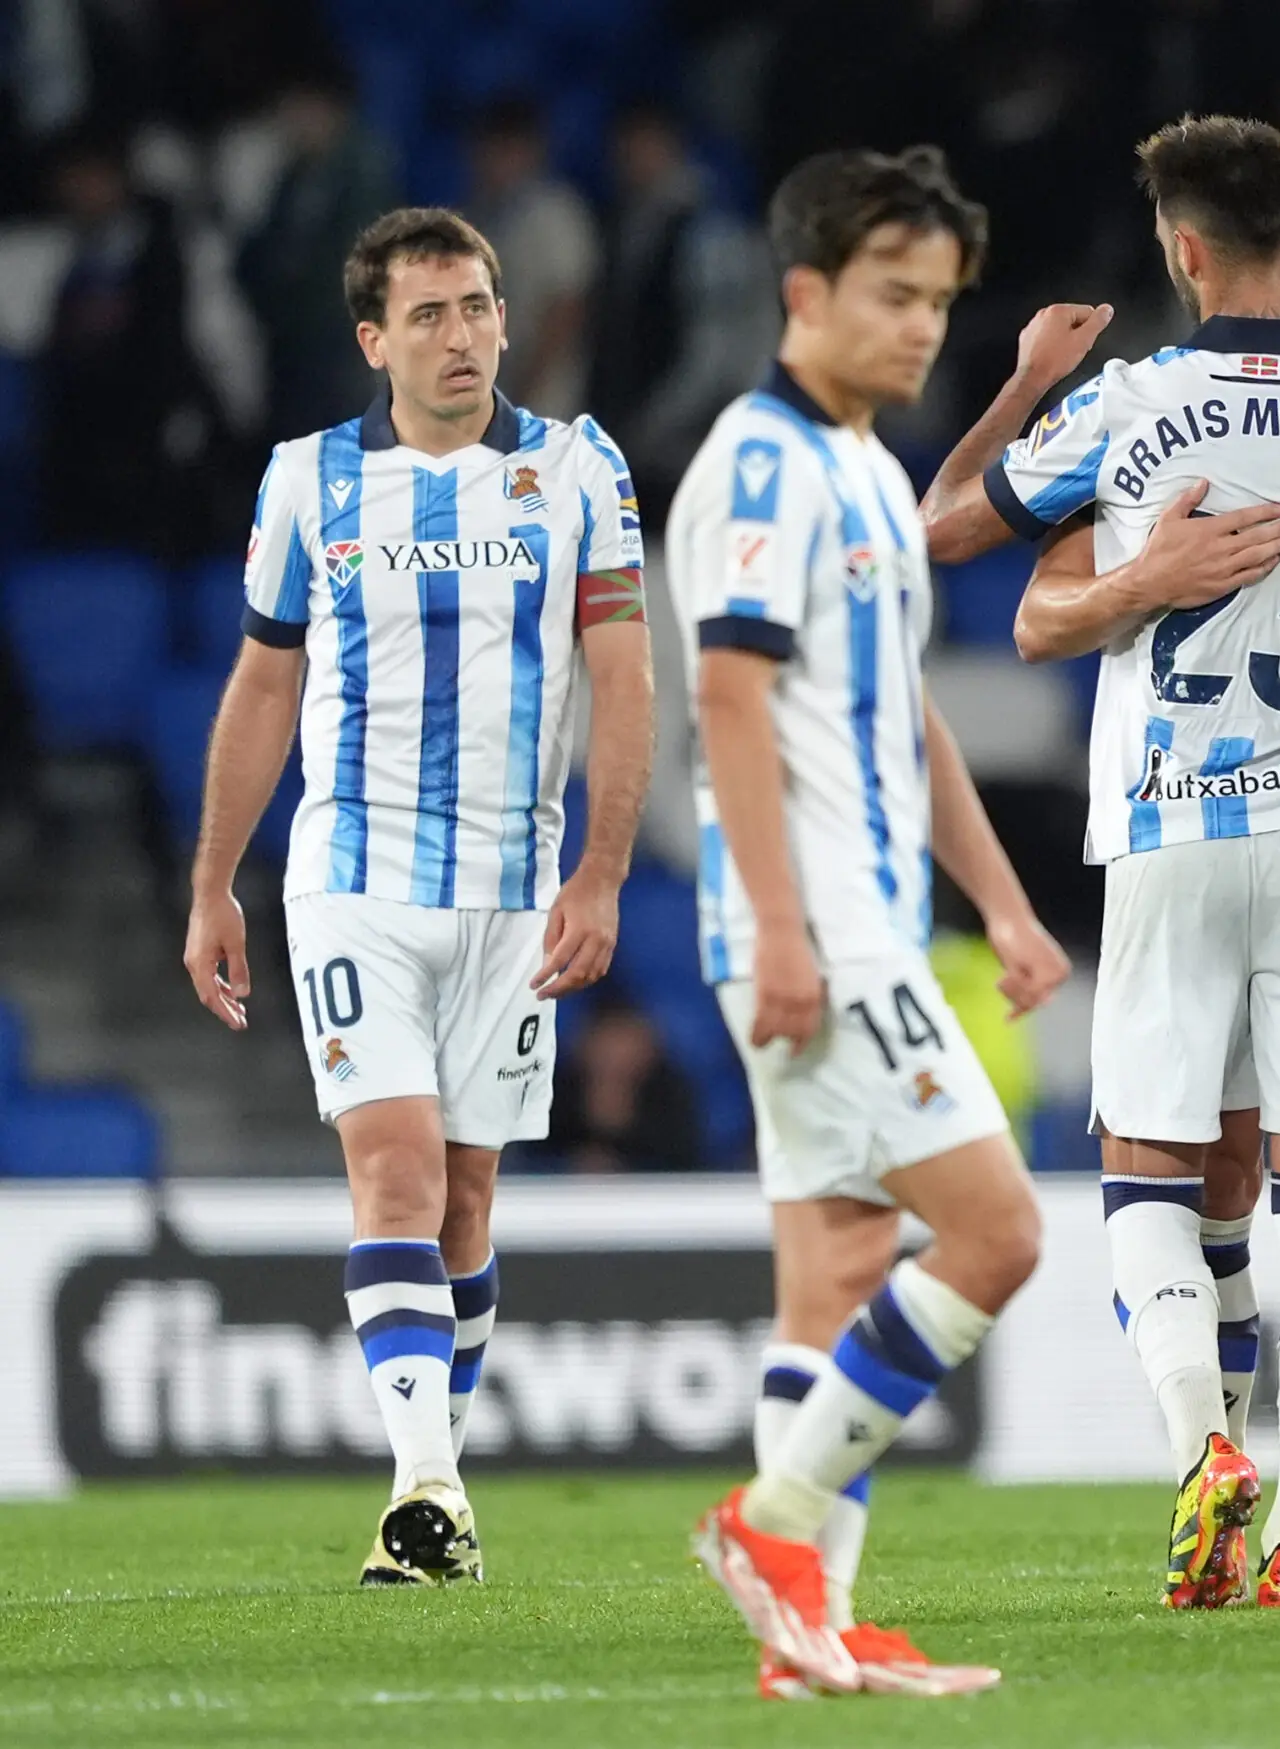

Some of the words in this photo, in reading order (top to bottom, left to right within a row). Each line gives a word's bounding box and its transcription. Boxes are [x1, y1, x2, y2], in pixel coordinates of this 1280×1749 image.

[1113, 398, 1230, 502] BRAIS
[378, 540, 537, 571] YASUDA
[303, 957, 363, 1037] 10
[845, 983, 944, 1070] 14
[1156, 1288, 1198, 1301] RS
